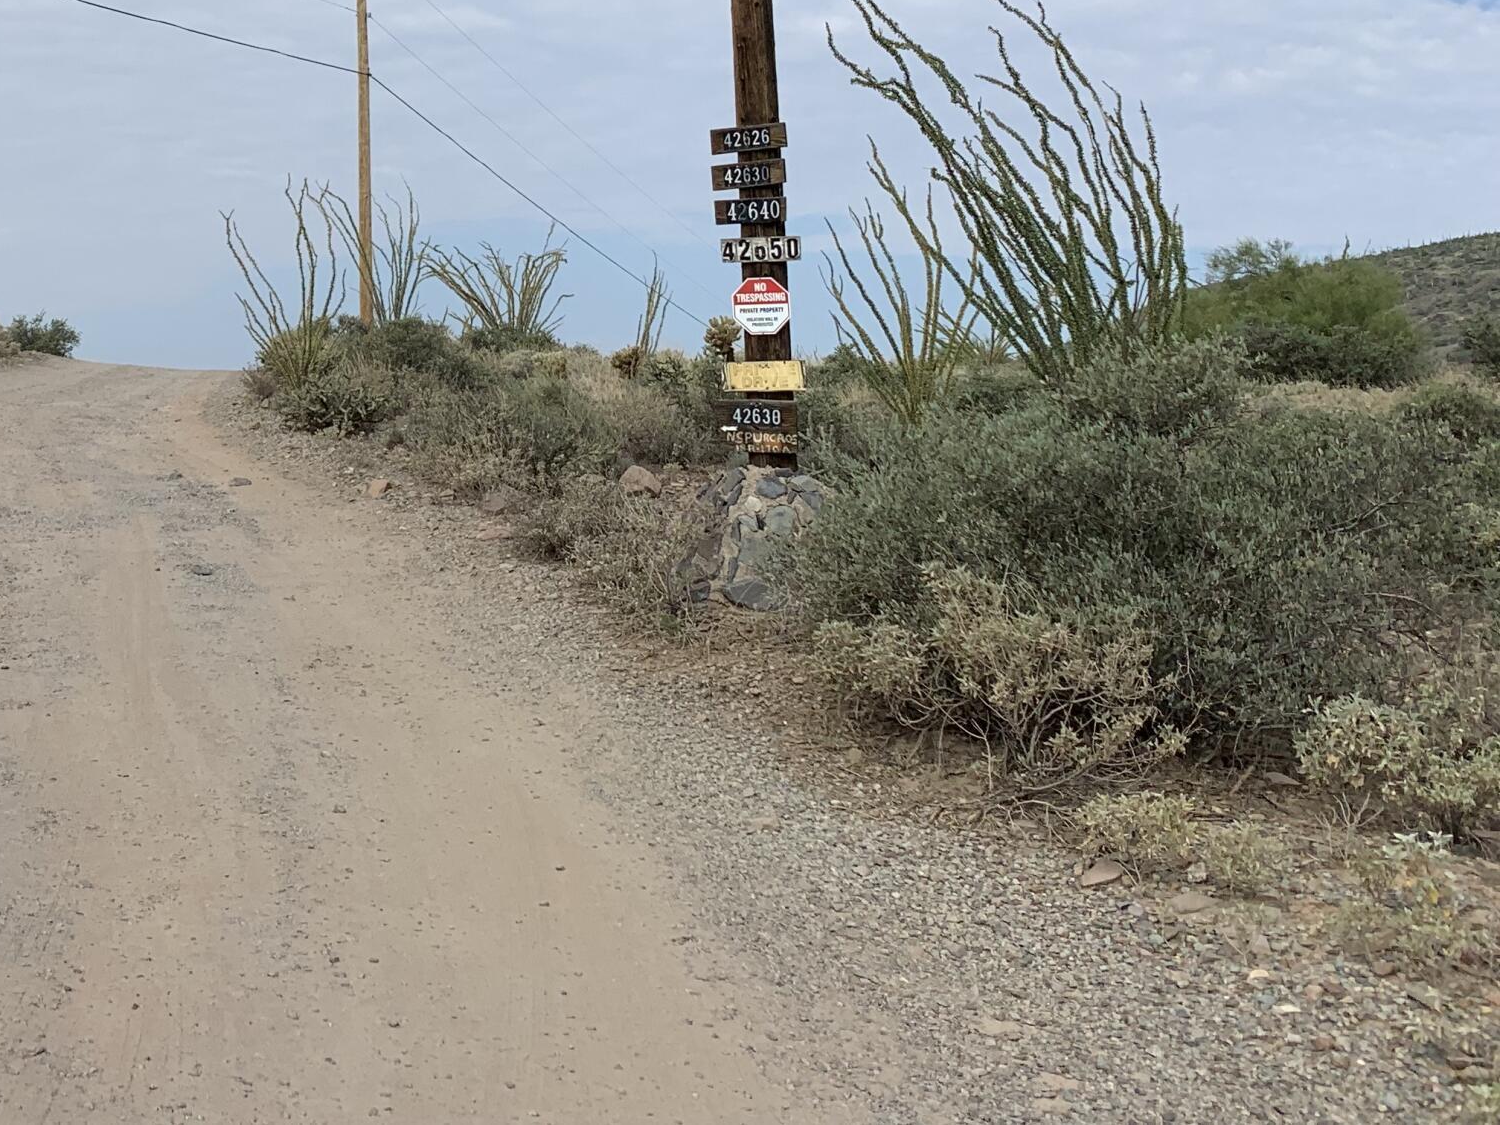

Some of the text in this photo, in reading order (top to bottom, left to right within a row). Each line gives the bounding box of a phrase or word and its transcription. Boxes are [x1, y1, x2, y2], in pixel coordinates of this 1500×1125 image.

[724, 129, 770, 148] 42626
[724, 166, 770, 184] 42630
[727, 200, 780, 221] 42640
[754, 282, 767, 292] NO
[736, 292, 786, 303] TRESPASSING
